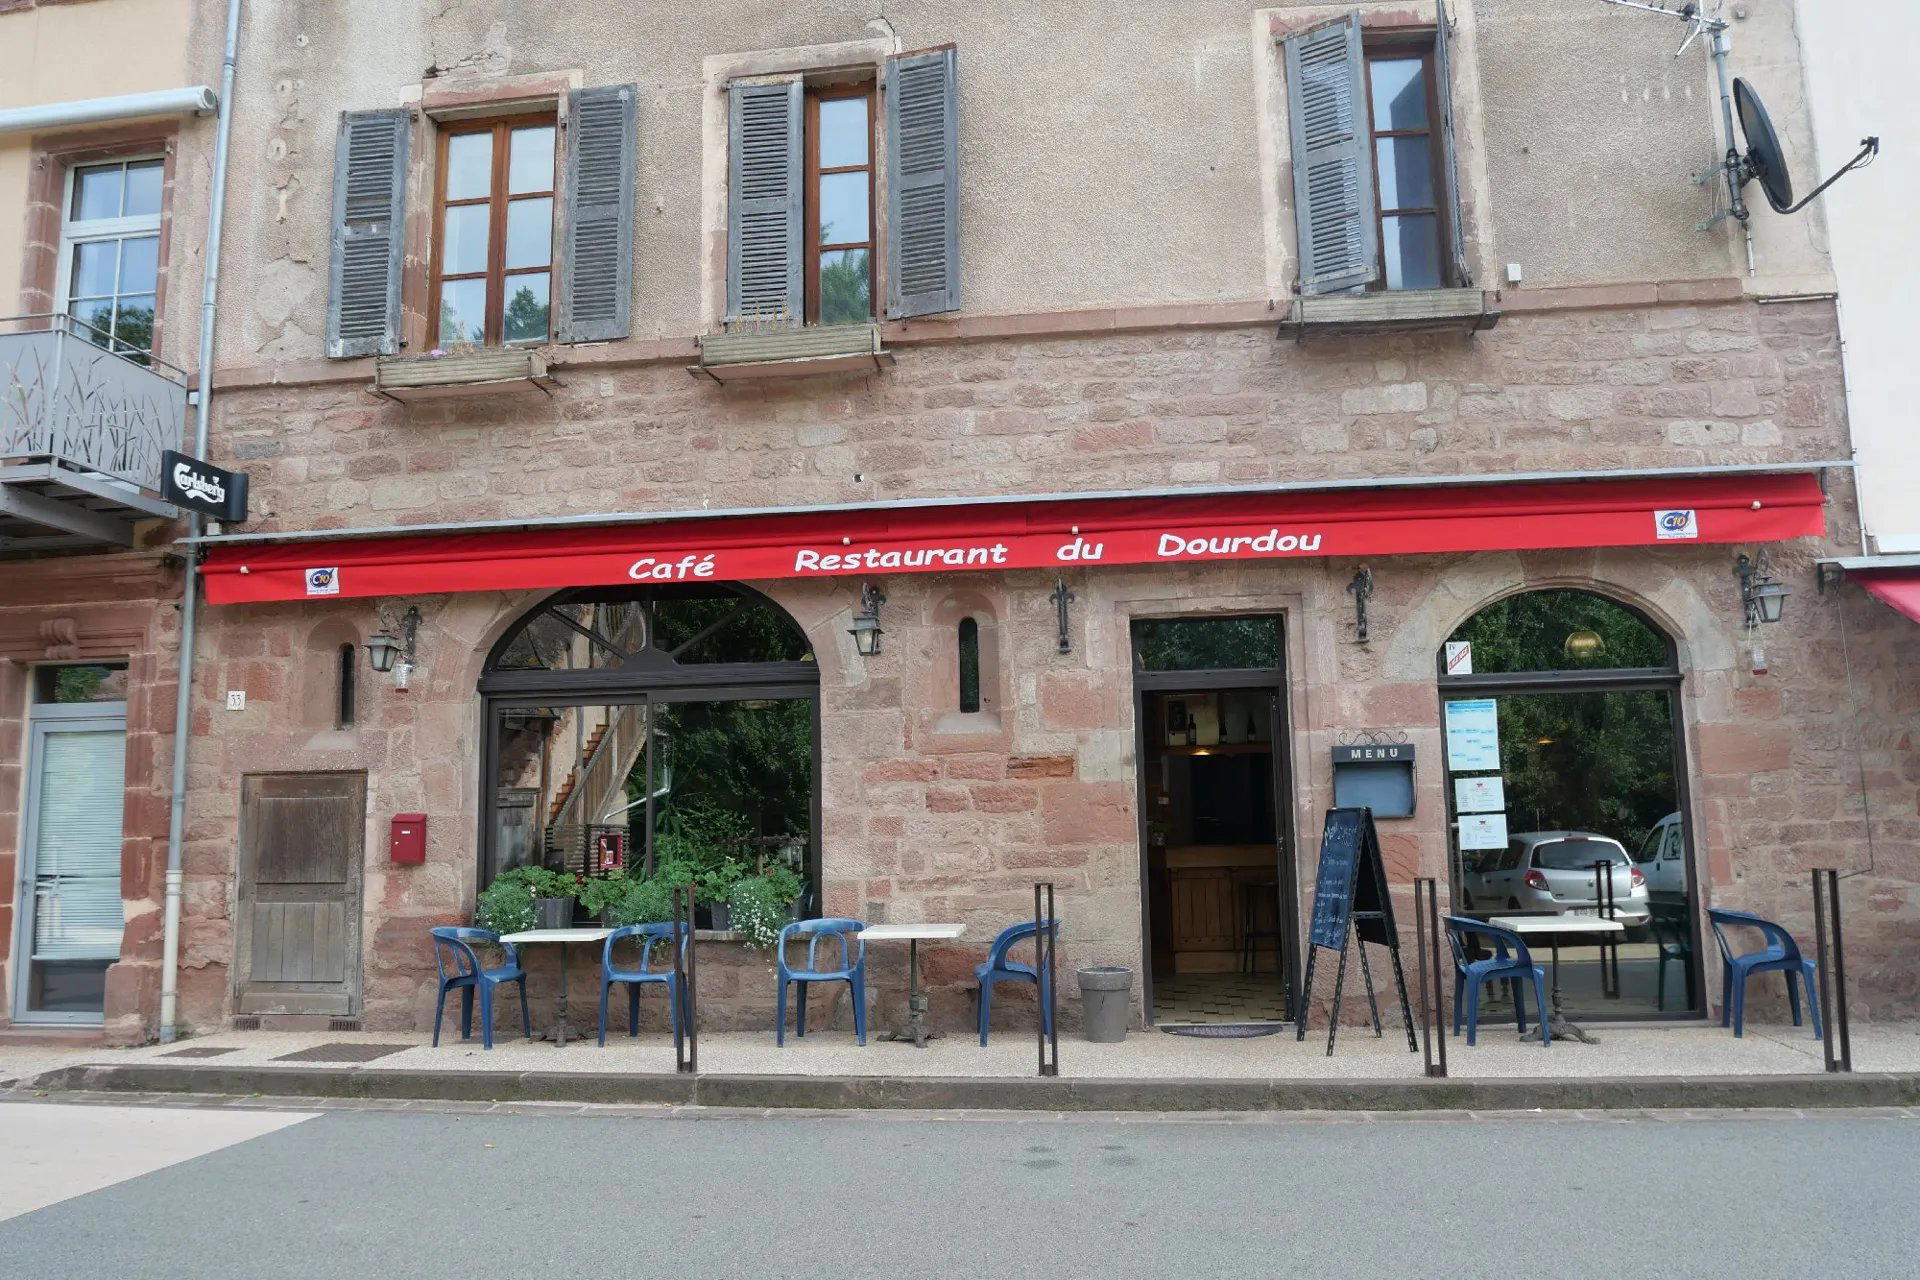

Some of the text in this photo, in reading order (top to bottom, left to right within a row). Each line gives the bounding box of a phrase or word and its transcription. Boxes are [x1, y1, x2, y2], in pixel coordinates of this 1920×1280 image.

[173, 462, 226, 503] Carlsberg
[628, 528, 1322, 580] Café Restaurant du Dourdou
[1350, 748, 1398, 759] MENU
